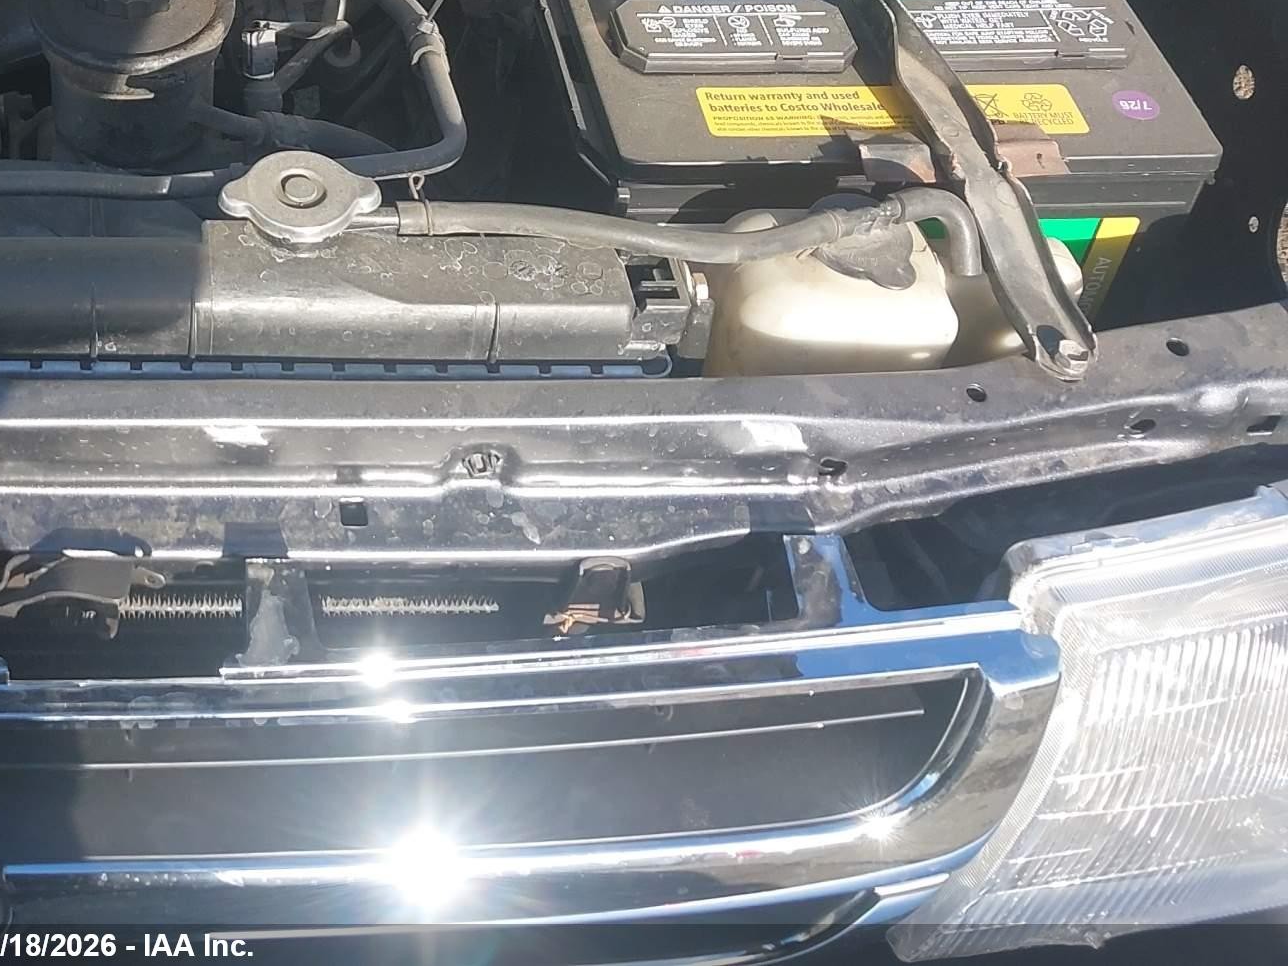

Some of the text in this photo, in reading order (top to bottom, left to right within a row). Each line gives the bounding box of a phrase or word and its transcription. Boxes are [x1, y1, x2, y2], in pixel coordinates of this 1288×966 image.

[672, 5, 731, 13] DANGER
[744, 4, 797, 12] POISON
[705, 91, 860, 102] Return warranty and used
[708, 102, 887, 112] batteries to Costco Wholesale
[1049, 111, 1074, 119] MUST
